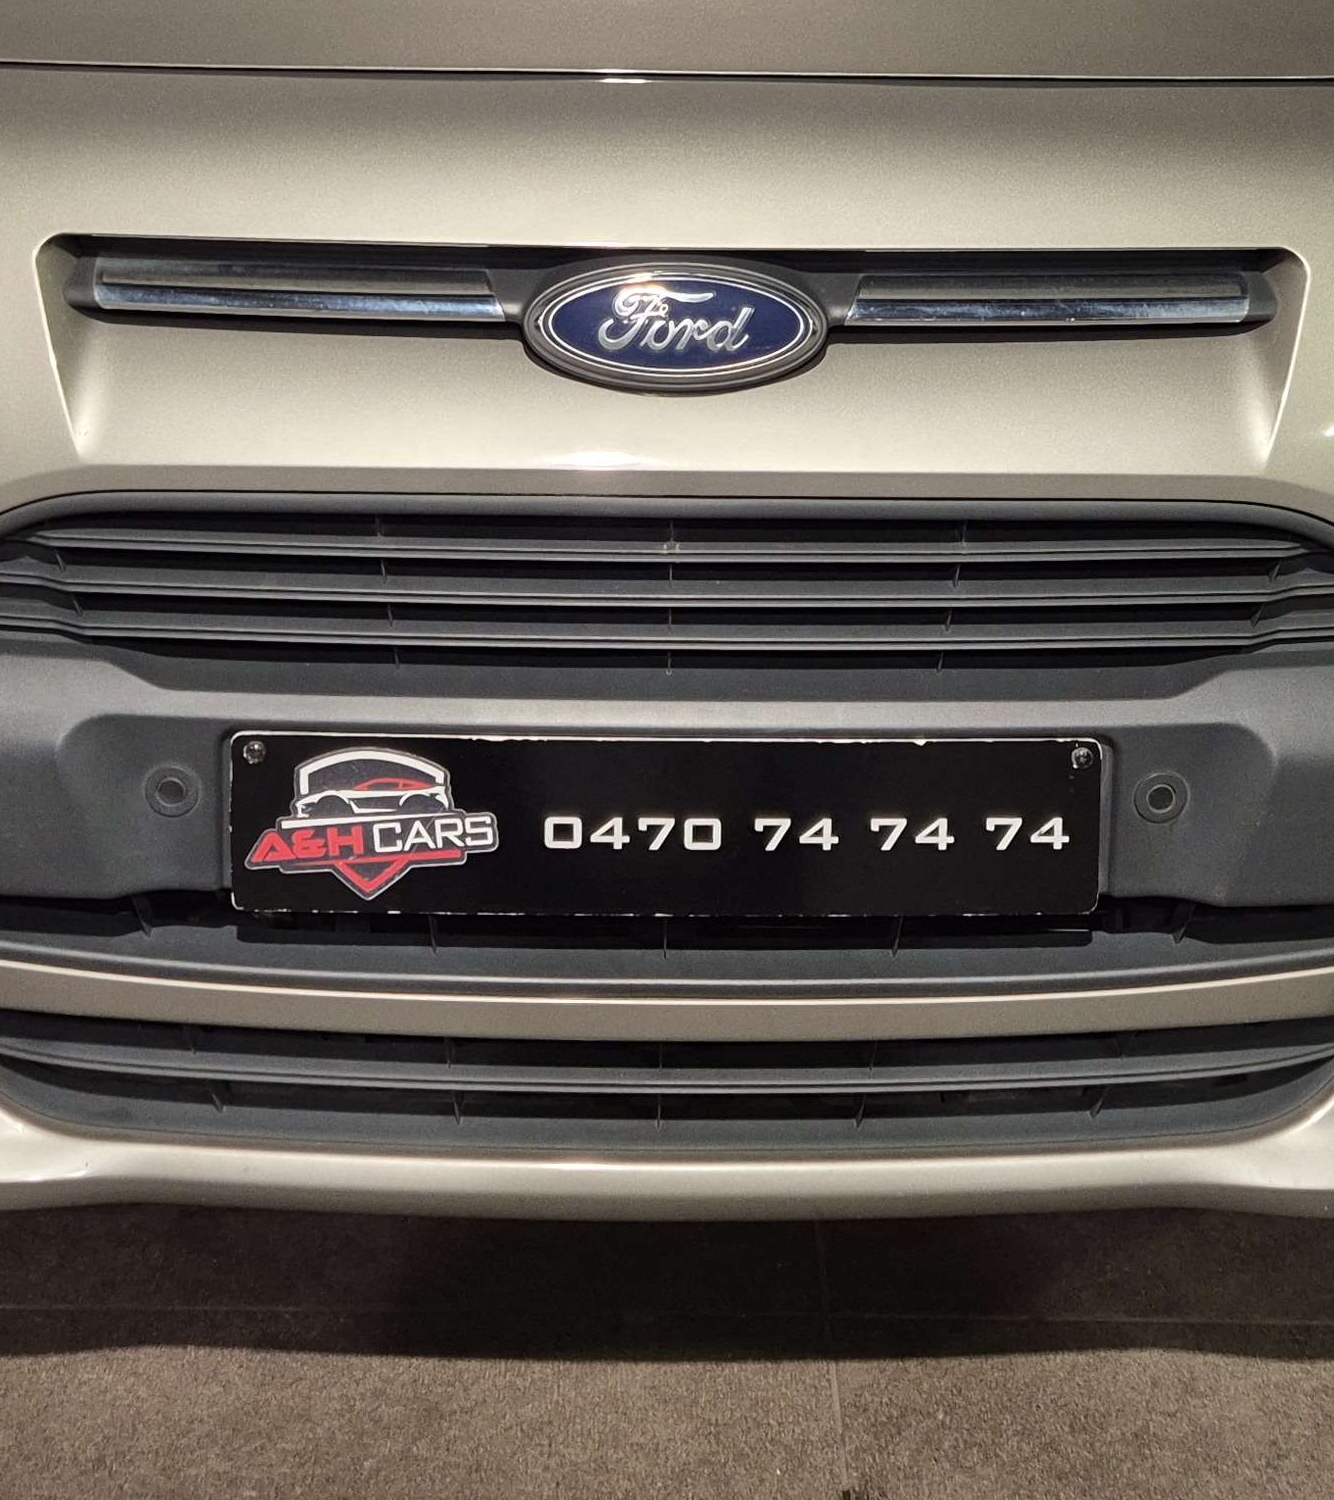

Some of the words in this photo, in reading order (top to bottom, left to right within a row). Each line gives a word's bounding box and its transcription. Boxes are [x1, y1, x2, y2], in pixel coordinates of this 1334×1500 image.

[597, 285, 756, 352] Ford
[251, 825, 365, 863] A&H
[372, 815, 494, 853] CARS
[543, 816, 722, 851] 0470
[754, 817, 839, 851] 74
[870, 817, 954, 851] 74
[985, 816, 1070, 851] 74
